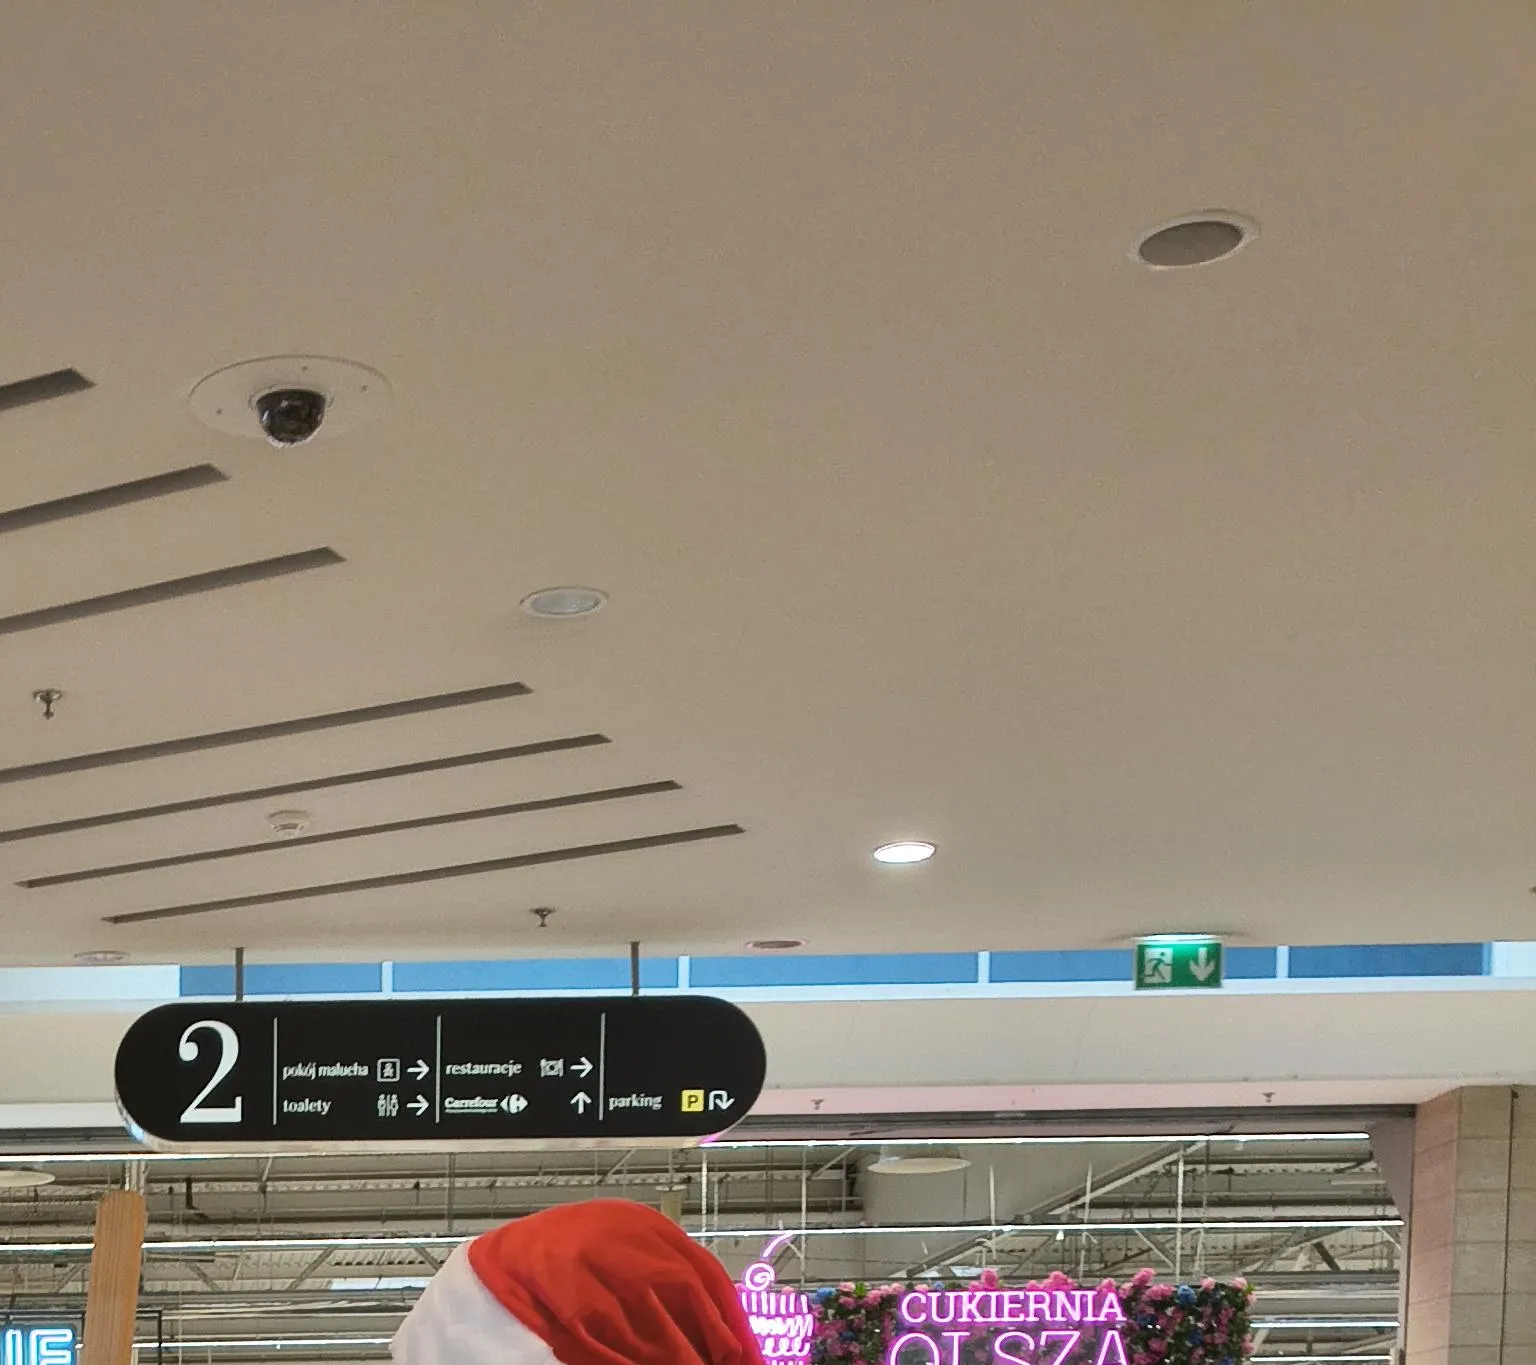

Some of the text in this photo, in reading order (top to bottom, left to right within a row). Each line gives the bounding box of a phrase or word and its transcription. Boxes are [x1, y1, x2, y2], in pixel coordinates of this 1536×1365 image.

[178, 1019, 243, 1124] 2
[282, 1062, 369, 1081] pokój malucha
[445, 1059, 523, 1078] restauracje
[282, 1098, 332, 1114] toalety
[444, 1095, 499, 1109] Carrefour
[608, 1093, 663, 1111] parking
[900, 1289, 1128, 1324] CUKIERNIA
